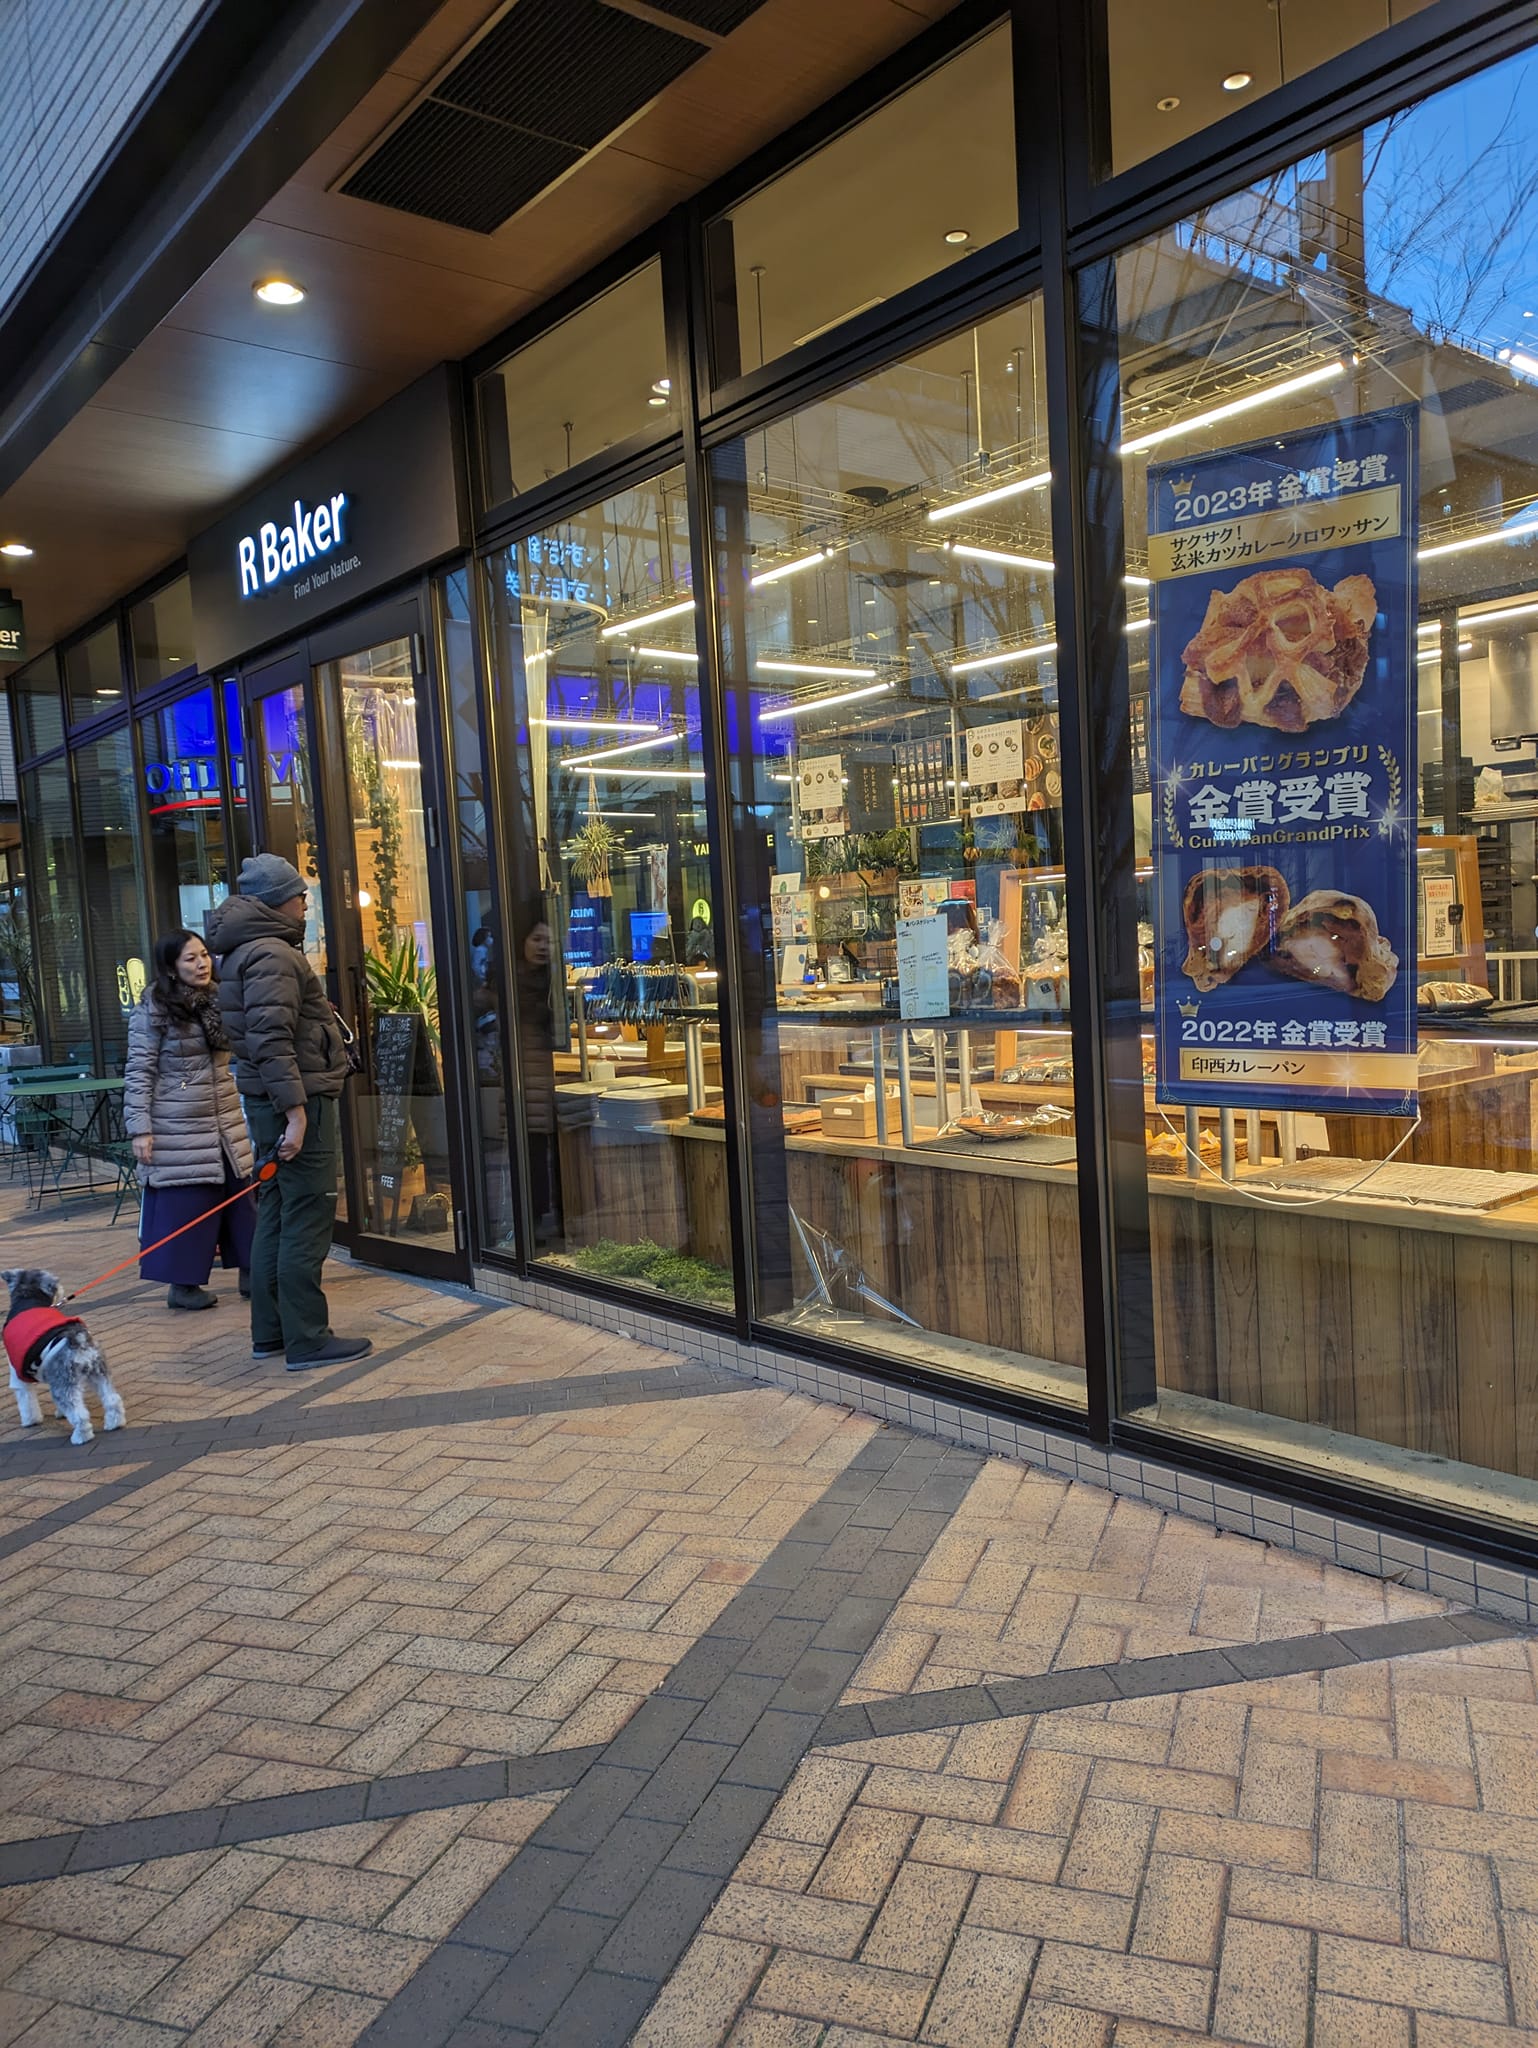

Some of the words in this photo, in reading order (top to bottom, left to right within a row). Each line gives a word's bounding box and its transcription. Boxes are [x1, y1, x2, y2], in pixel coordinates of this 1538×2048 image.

[1174, 480, 1273, 523] 2023年
[238, 535, 260, 596] R
[260, 492, 346, 584] Baker
[1170, 515, 1391, 572] 玄米カツカレークロワッサン
[293, 578, 311, 600] Find
[311, 571, 330, 590] Your
[330, 555, 362, 581] Nature.
[1189, 744, 1370, 779] カレーパングランプリ
[1187, 771, 1373, 829] 金賞受賞
[1180, 1019, 1278, 1046] 2022年
[1280, 1019, 1388, 1049] 金賞受賞
[1191, 1056, 1307, 1076] 印西カレーパン
